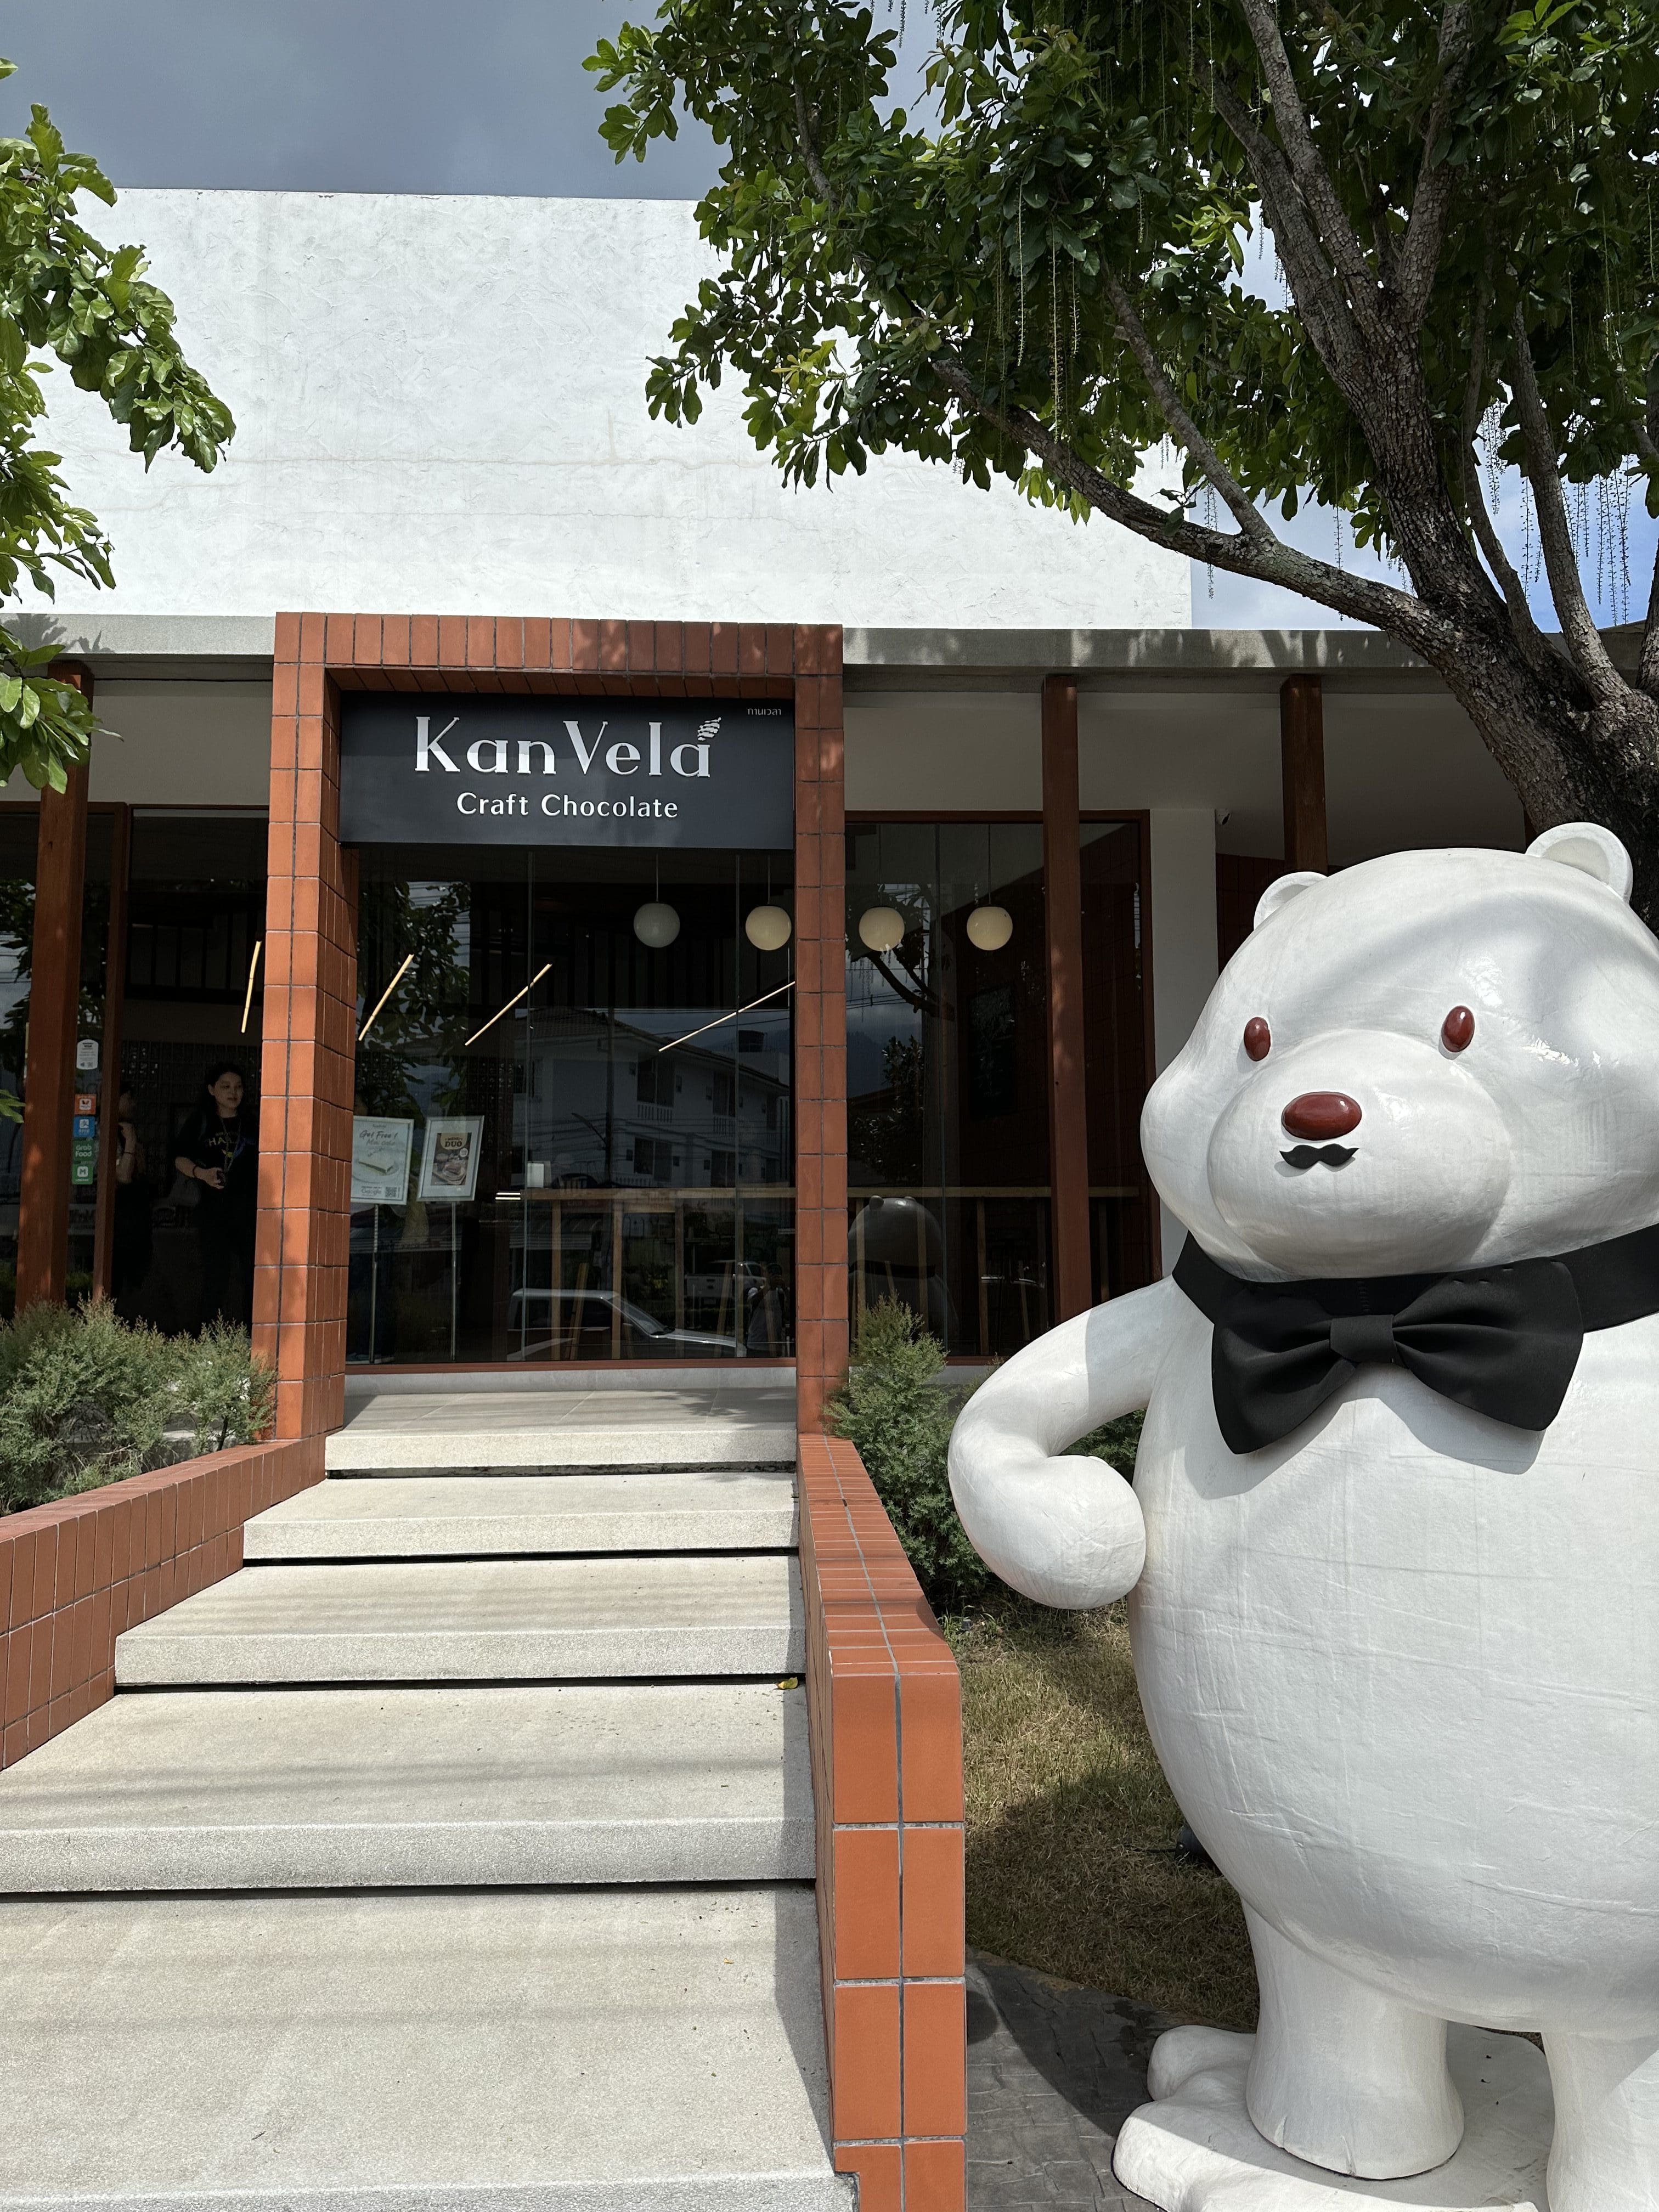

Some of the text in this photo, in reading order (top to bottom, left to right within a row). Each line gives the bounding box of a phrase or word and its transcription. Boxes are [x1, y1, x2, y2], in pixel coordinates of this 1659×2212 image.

[415, 716, 711, 777] KanVela
[456, 792, 679, 817] Craft Chocolate
